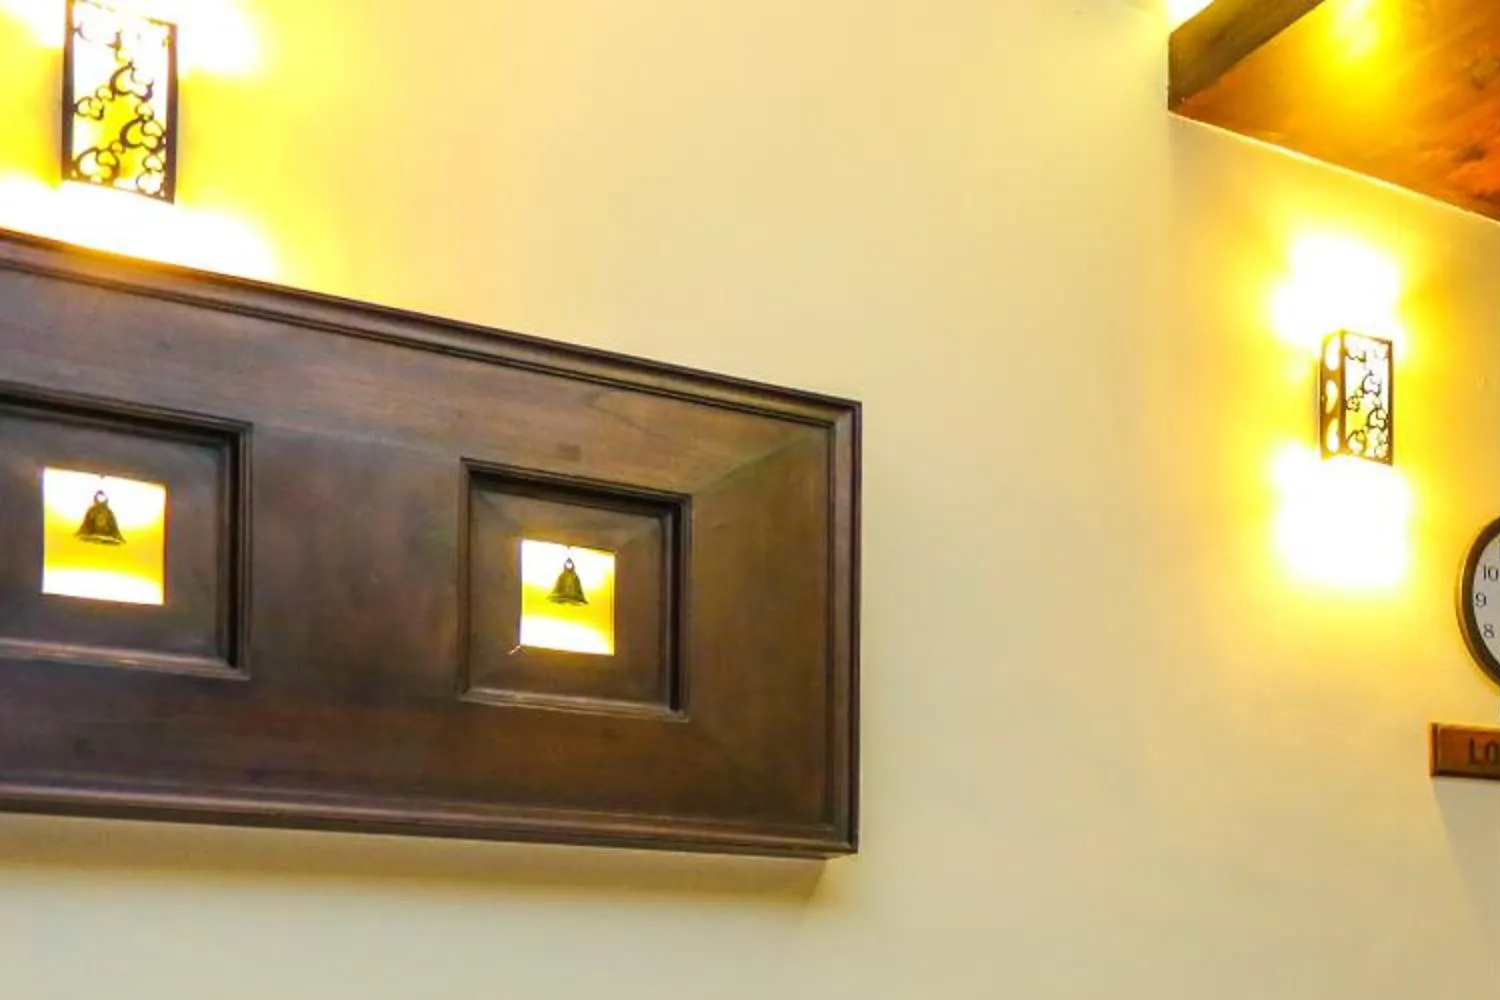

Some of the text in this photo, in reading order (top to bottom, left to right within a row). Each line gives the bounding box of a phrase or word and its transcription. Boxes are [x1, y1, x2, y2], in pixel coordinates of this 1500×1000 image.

[1483, 565, 1499, 581] 10
[1475, 592, 1487, 607] 9
[1483, 624, 1495, 638] 8
